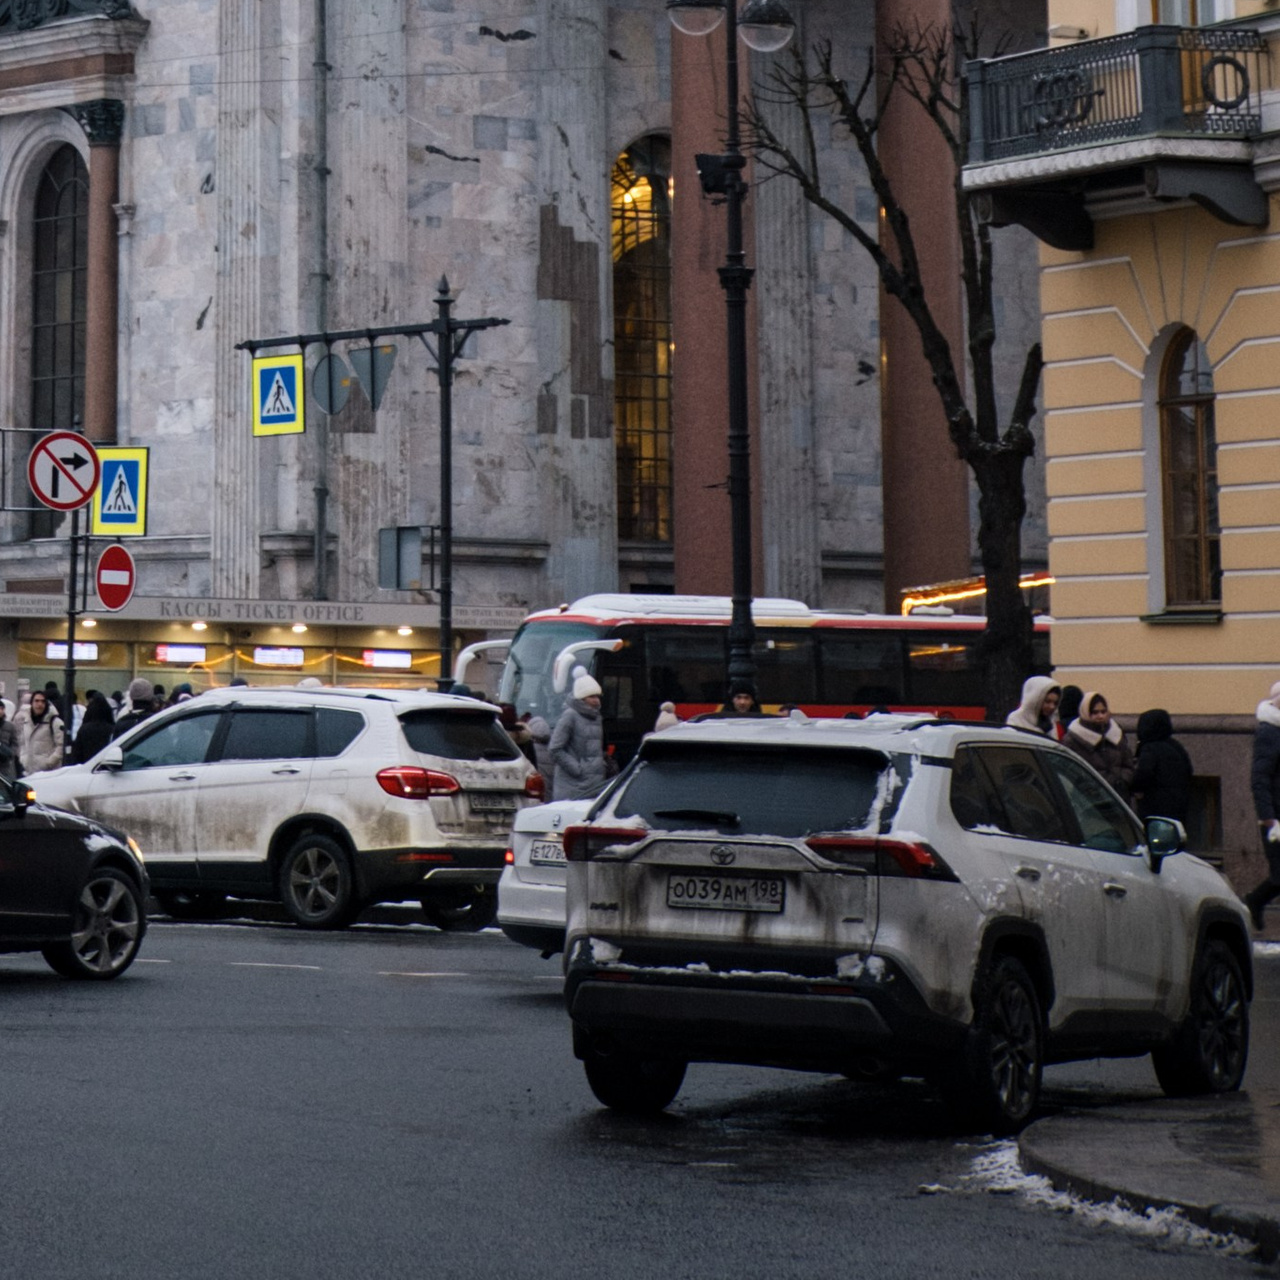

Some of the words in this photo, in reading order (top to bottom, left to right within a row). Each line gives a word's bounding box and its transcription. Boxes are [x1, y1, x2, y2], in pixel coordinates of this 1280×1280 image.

[159, 601, 221, 618] КАССЫ
[234, 603, 295, 620] TICKET
[303, 605, 364, 621] OFFICE
[751, 881, 779, 897] 198
